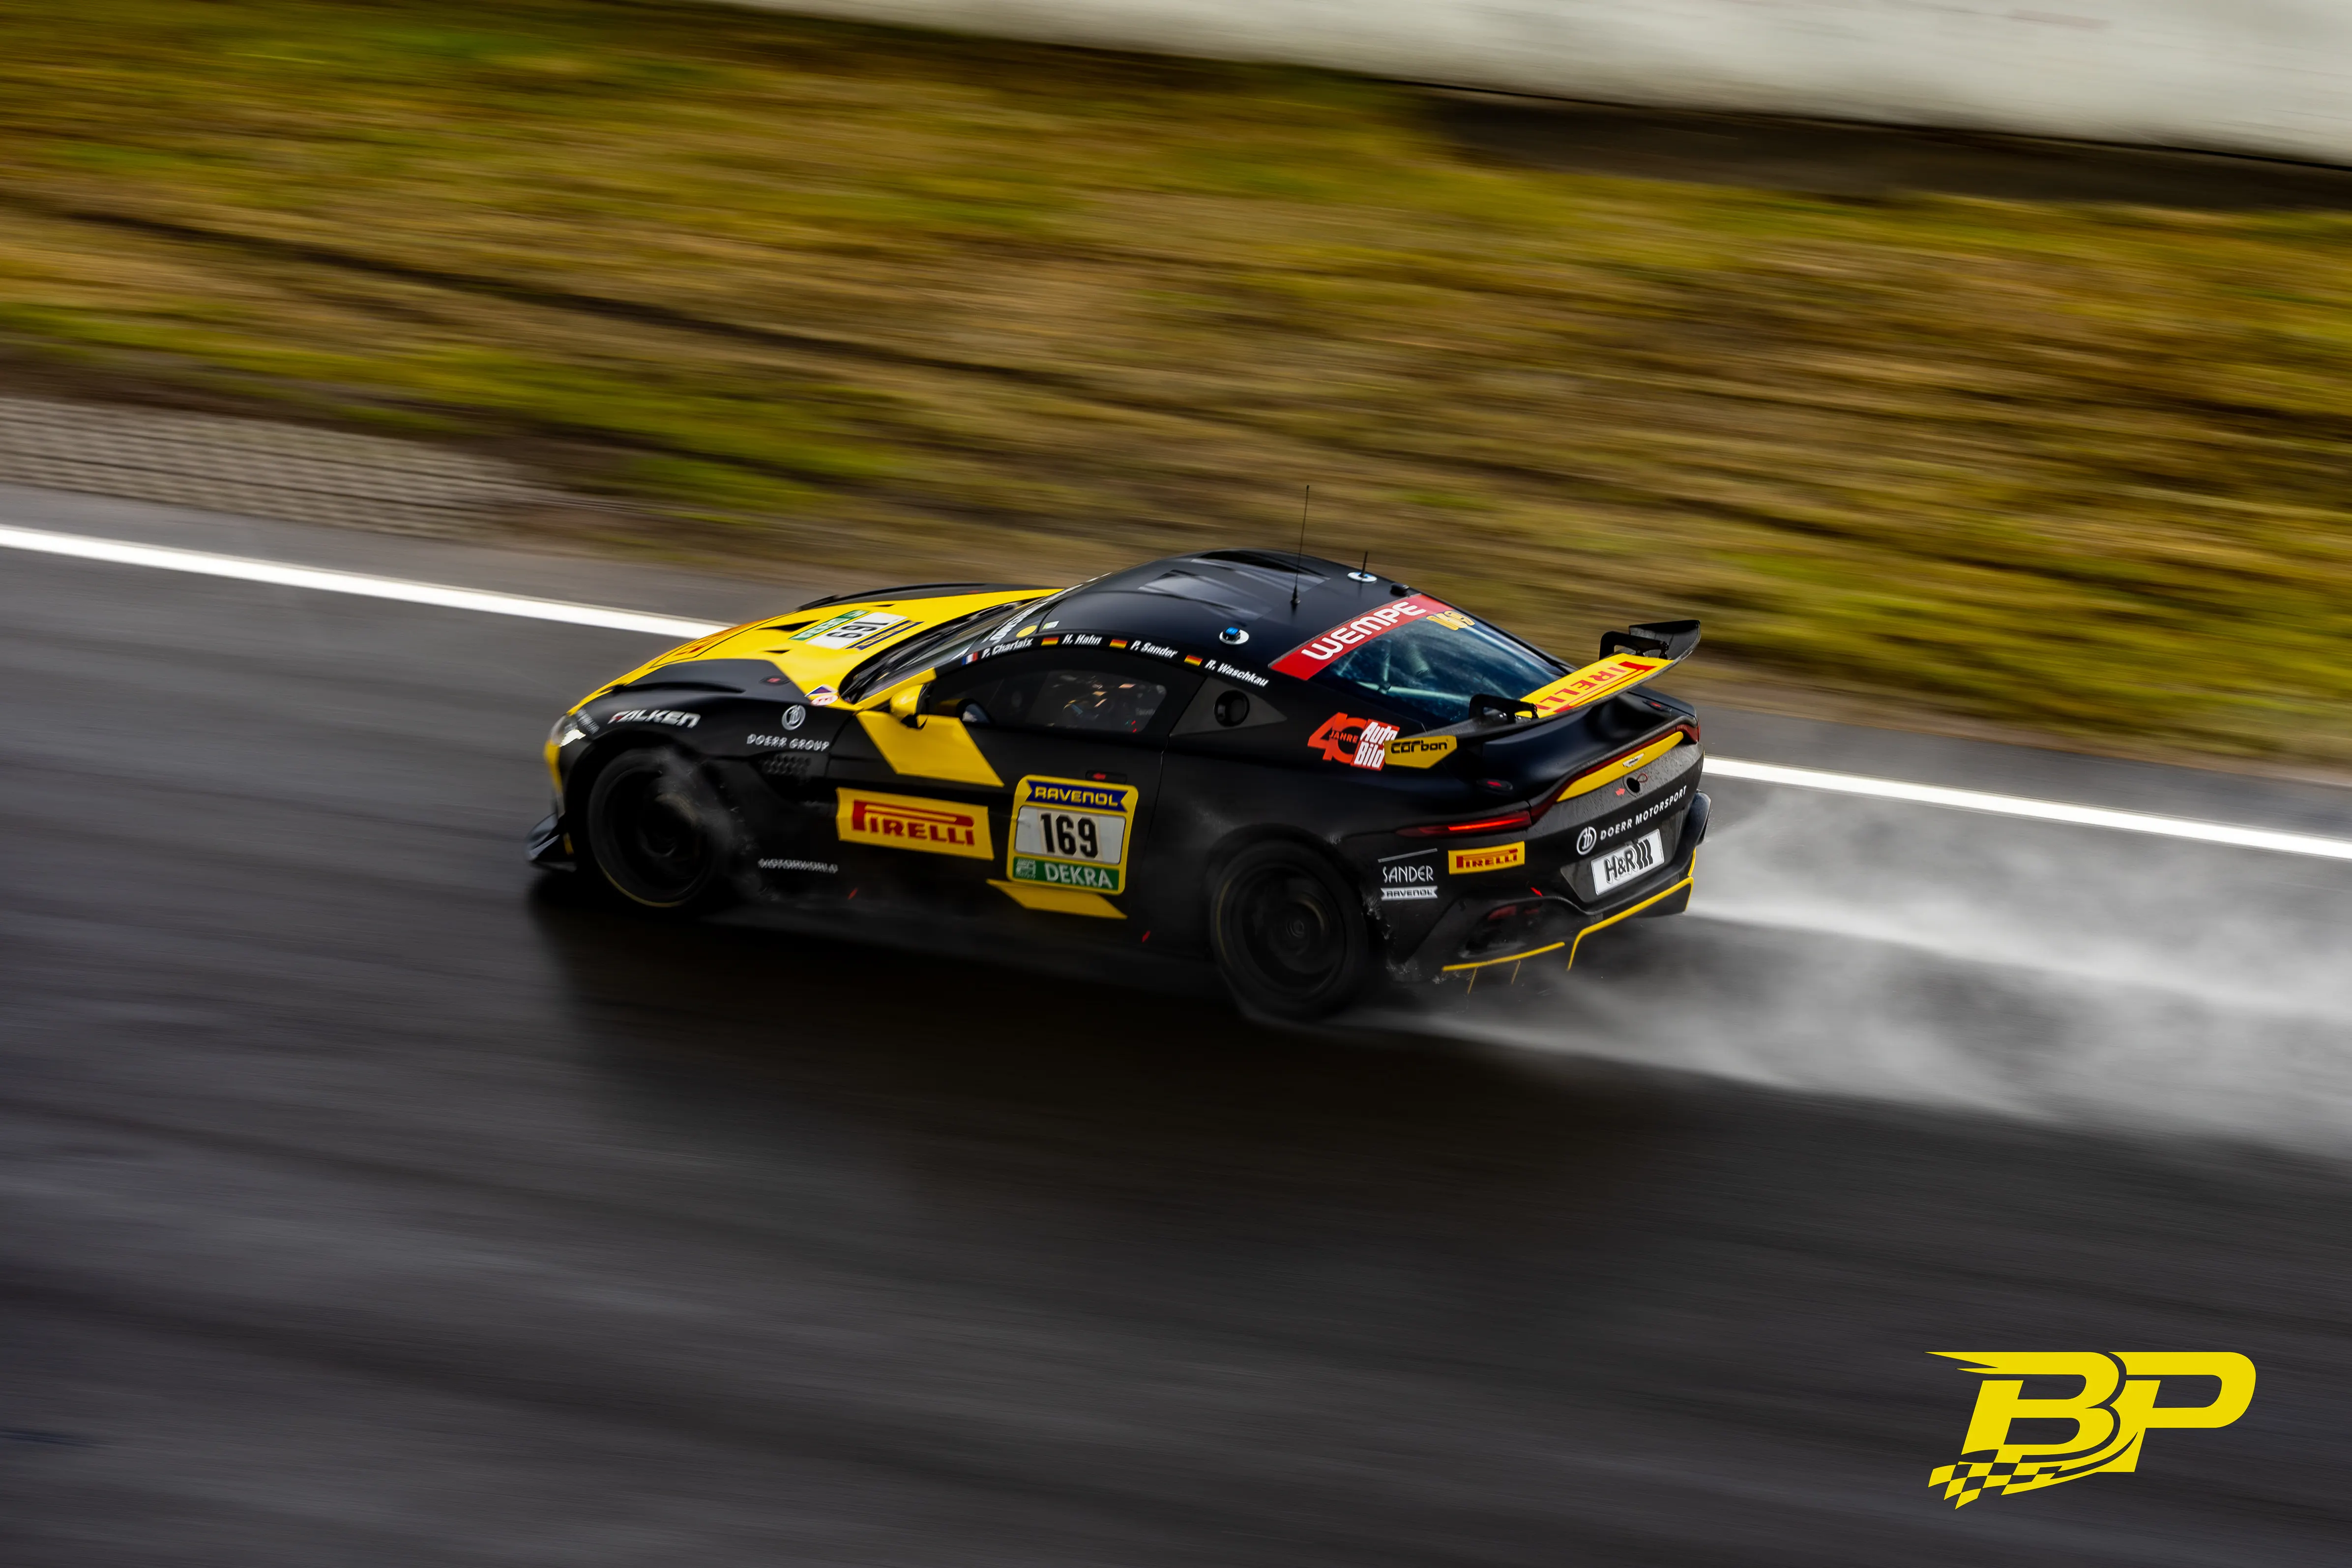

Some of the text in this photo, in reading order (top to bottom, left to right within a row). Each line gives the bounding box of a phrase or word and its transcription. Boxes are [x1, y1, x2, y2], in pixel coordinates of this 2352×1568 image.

[826, 621, 889, 639] 169
[1301, 601, 1426, 660] WEMPE
[1426, 611, 1475, 631] 169
[981, 648, 991, 659] P.
[1130, 640, 1178, 659] P. Sander
[1205, 659, 1269, 688] R. Waschkau
[608, 710, 701, 728] FALKEN
[747, 734, 829, 752] DOERR GROUP
[1329, 731, 1359, 743] JAHRE
[1035, 786, 1118, 807] RAVENOL
[852, 799, 974, 846] PIRELLI
[1600, 785, 1687, 840] DOERR MOTORSPORT
[1040, 813, 1099, 859] 169
[1456, 848, 1518, 869] PIRELLI
[1044, 863, 1114, 889] DEKRA
[1382, 865, 1434, 884] SANDER
[1386, 888, 1433, 897] RAVENOL
